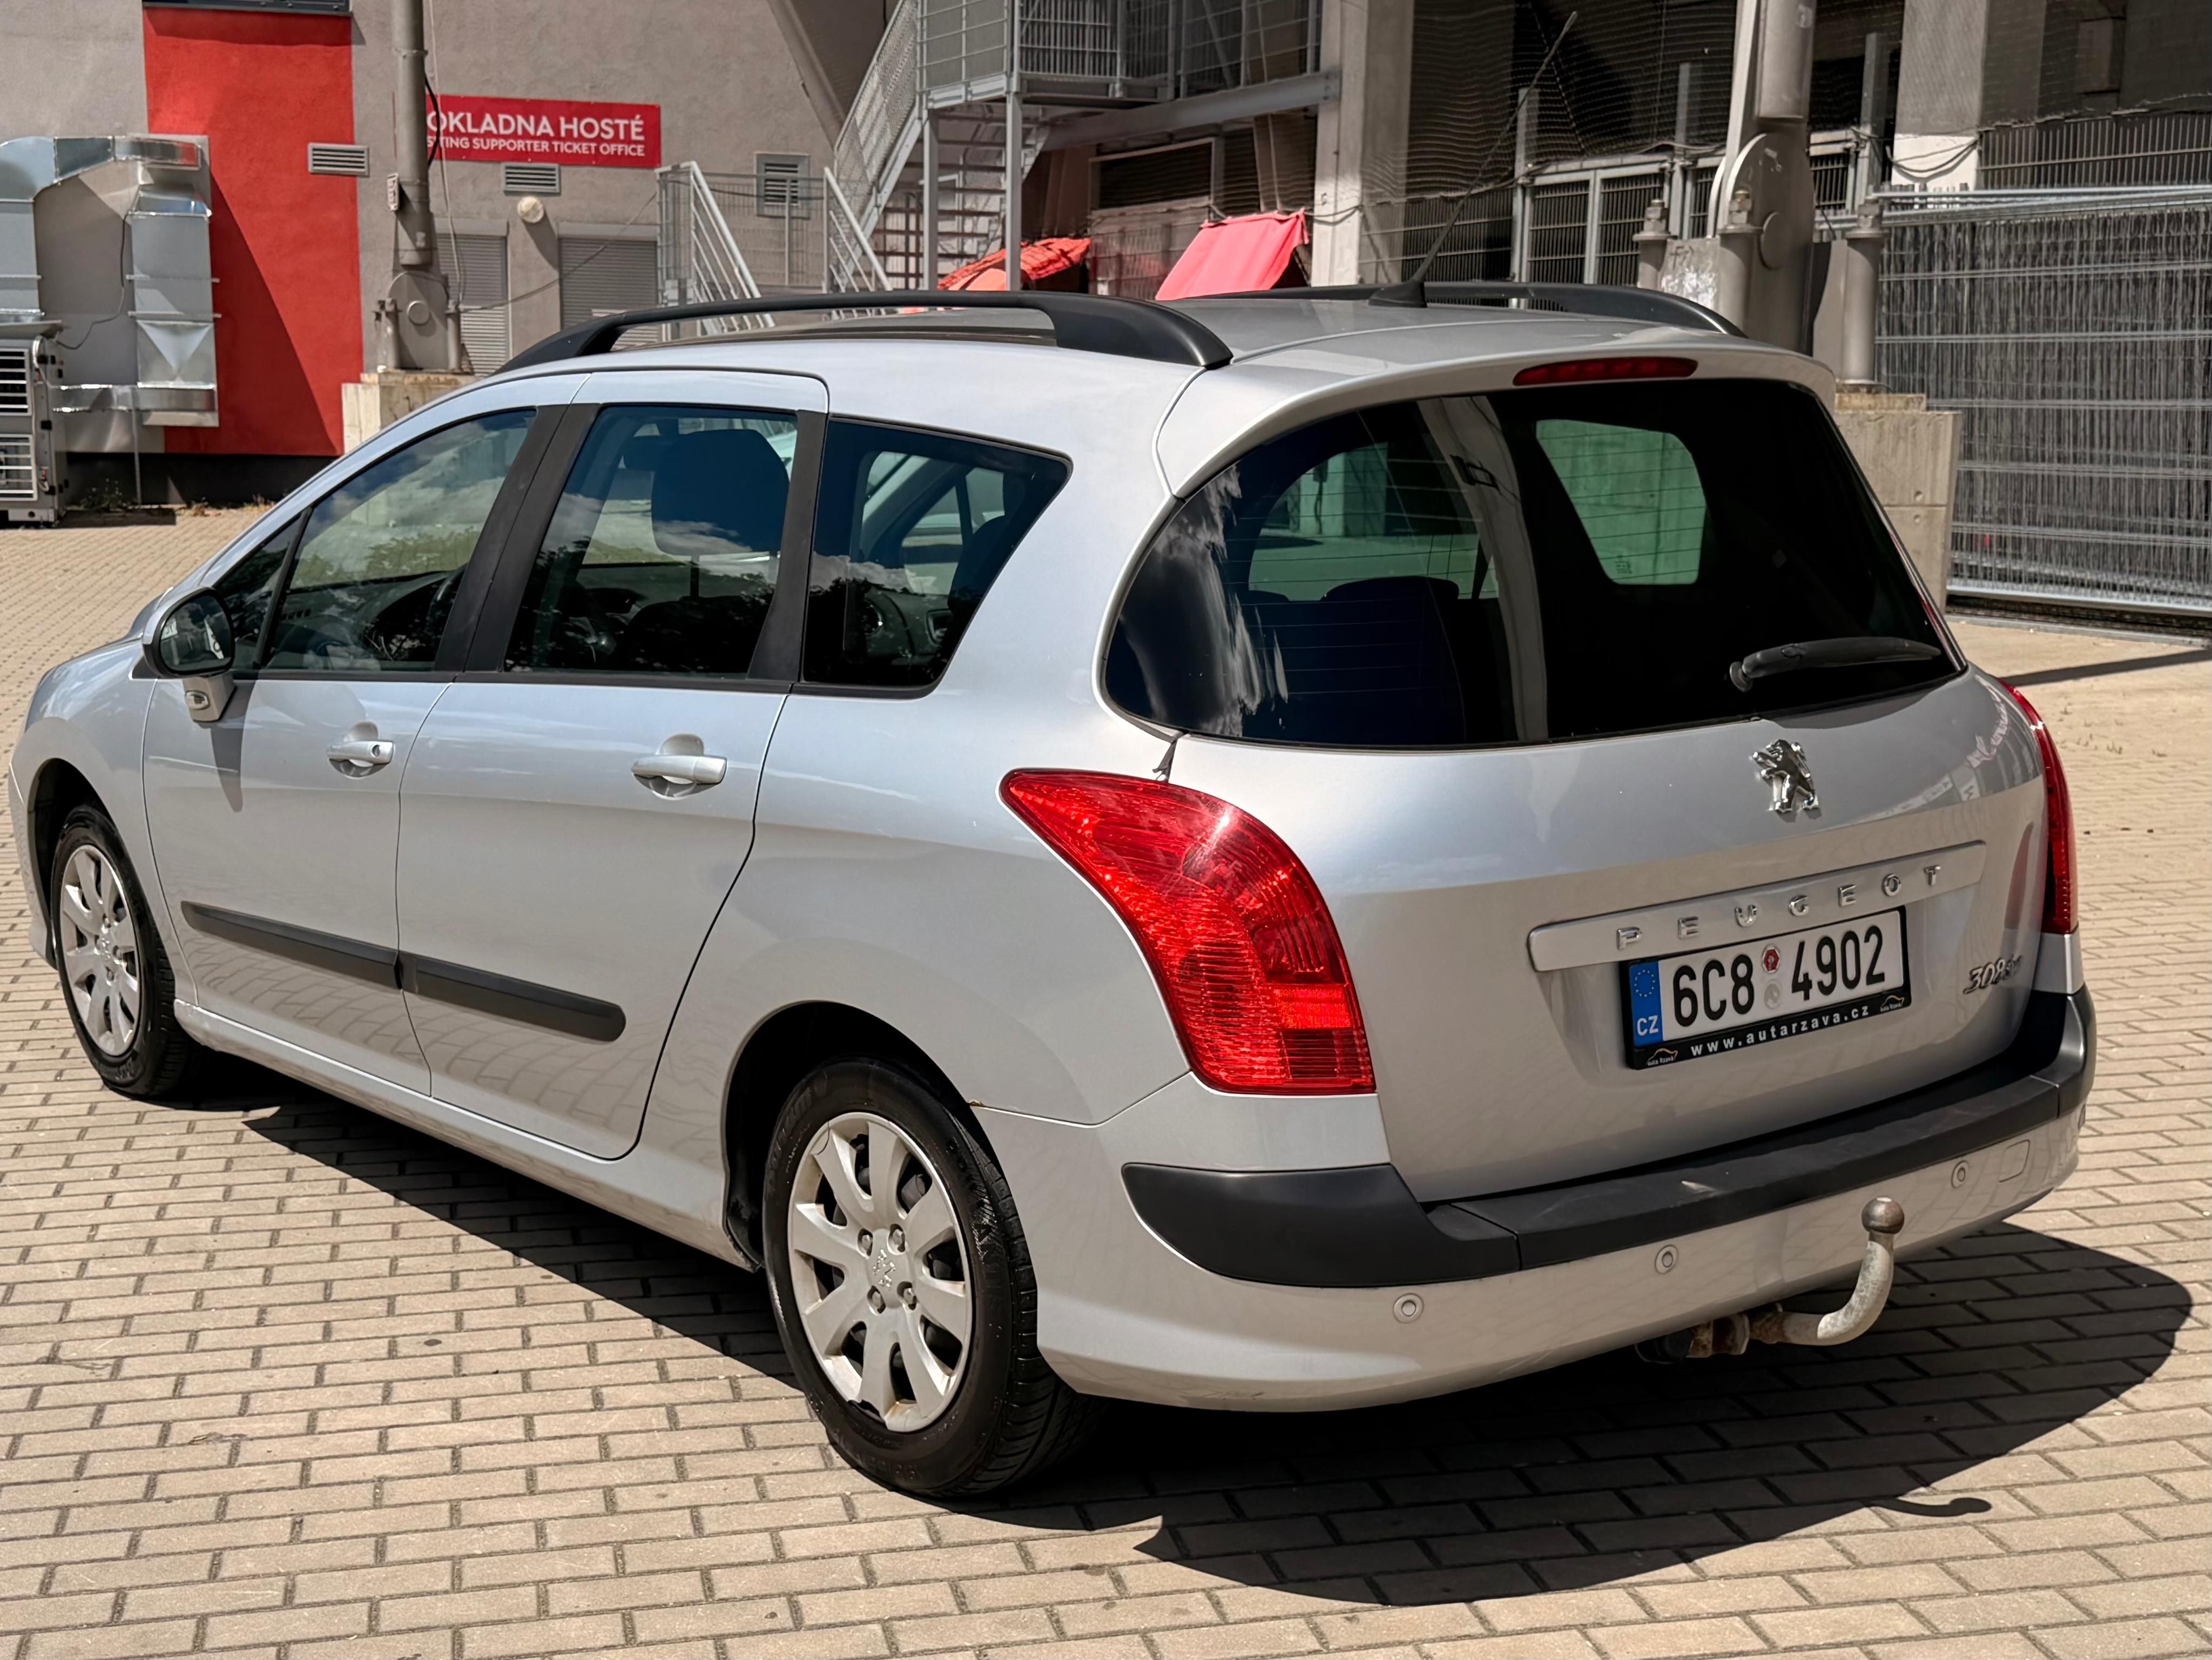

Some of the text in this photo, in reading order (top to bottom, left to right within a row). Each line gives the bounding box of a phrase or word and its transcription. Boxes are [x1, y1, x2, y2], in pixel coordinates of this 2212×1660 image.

[559, 114, 645, 140] HOSTÉ
[473, 137, 550, 152] SUPPORTER
[551, 141, 597, 154] TICKET
[599, 143, 645, 157] OFFICE
[1616, 864, 1942, 950] PEUGEOT
[1673, 925, 1885, 1027] 6C8 4902
[1637, 1014, 1659, 1036] CZ
[1690, 1005, 1870, 1057] www.autarzava.cz
